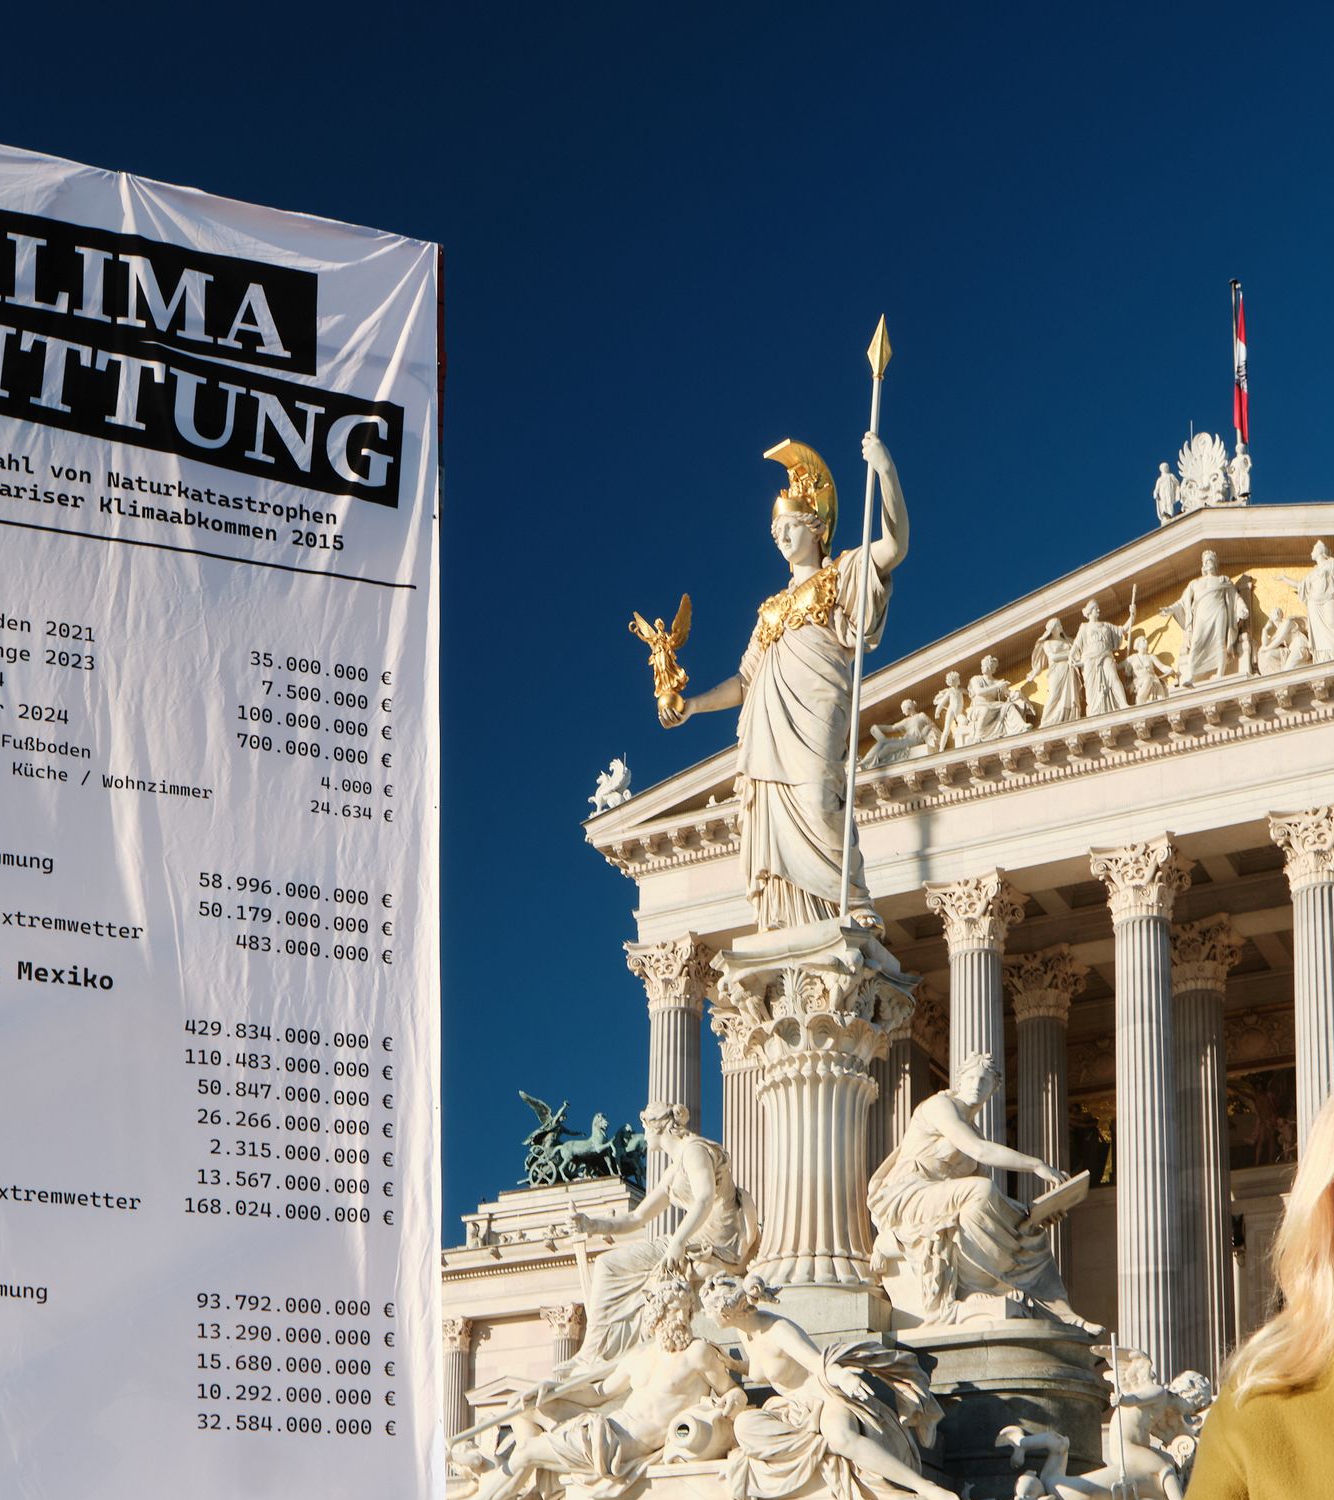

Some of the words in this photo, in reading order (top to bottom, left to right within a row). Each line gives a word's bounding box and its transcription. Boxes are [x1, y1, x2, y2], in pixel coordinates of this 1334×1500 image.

[51, 466, 91, 484] von
[107, 470, 336, 525] Naturkatastrophen
[100, 496, 276, 541] Klimaabkommen
[292, 529, 344, 551] 2015
[46, 621, 95, 643] 2021
[46, 650, 95, 672] 2023
[250, 651, 369, 682] 35.000.000
[381, 671, 392, 685] €
[262, 680, 368, 709] 7.500.000
[381, 698, 392, 712] €
[19, 704, 69, 724] 2024
[238, 705, 368, 737] 100.000.000
[381, 725, 392, 740] €
[2, 734, 90, 759] Fußboden
[237, 733, 368, 764] 700.000.000
[381, 753, 392, 768] €
[13, 762, 67, 782] Küche
[81, 770, 90, 785] /
[102, 774, 213, 799] Wohnzimmer
[321, 776, 372, 794] 4.000
[384, 784, 393, 797] €
[310, 800, 373, 820] 24.634
[384, 809, 393, 822] €
[199, 872, 368, 905] 58.996.000.000
[381, 894, 392, 908] €
[236, 935, 368, 962] 483.000.000
[380, 950, 392, 965] €
[18, 961, 113, 990] Mexiko
[185, 1020, 368, 1049] 429.834.000.000
[382, 1037, 393, 1052] €
[186, 1049, 369, 1078] 110.483.000.000
[382, 1065, 393, 1080] €
[211, 1139, 369, 1164] 2.315.000.000
[383, 1152, 393, 1167] €
[185, 1197, 370, 1223] 168.024.000.000
[383, 1210, 394, 1225] €
[197, 1292, 370, 1316] 93.792.000.000
[383, 1302, 395, 1318] €
[197, 1323, 370, 1346] 13.290.000.000
[384, 1332, 395, 1348] €
